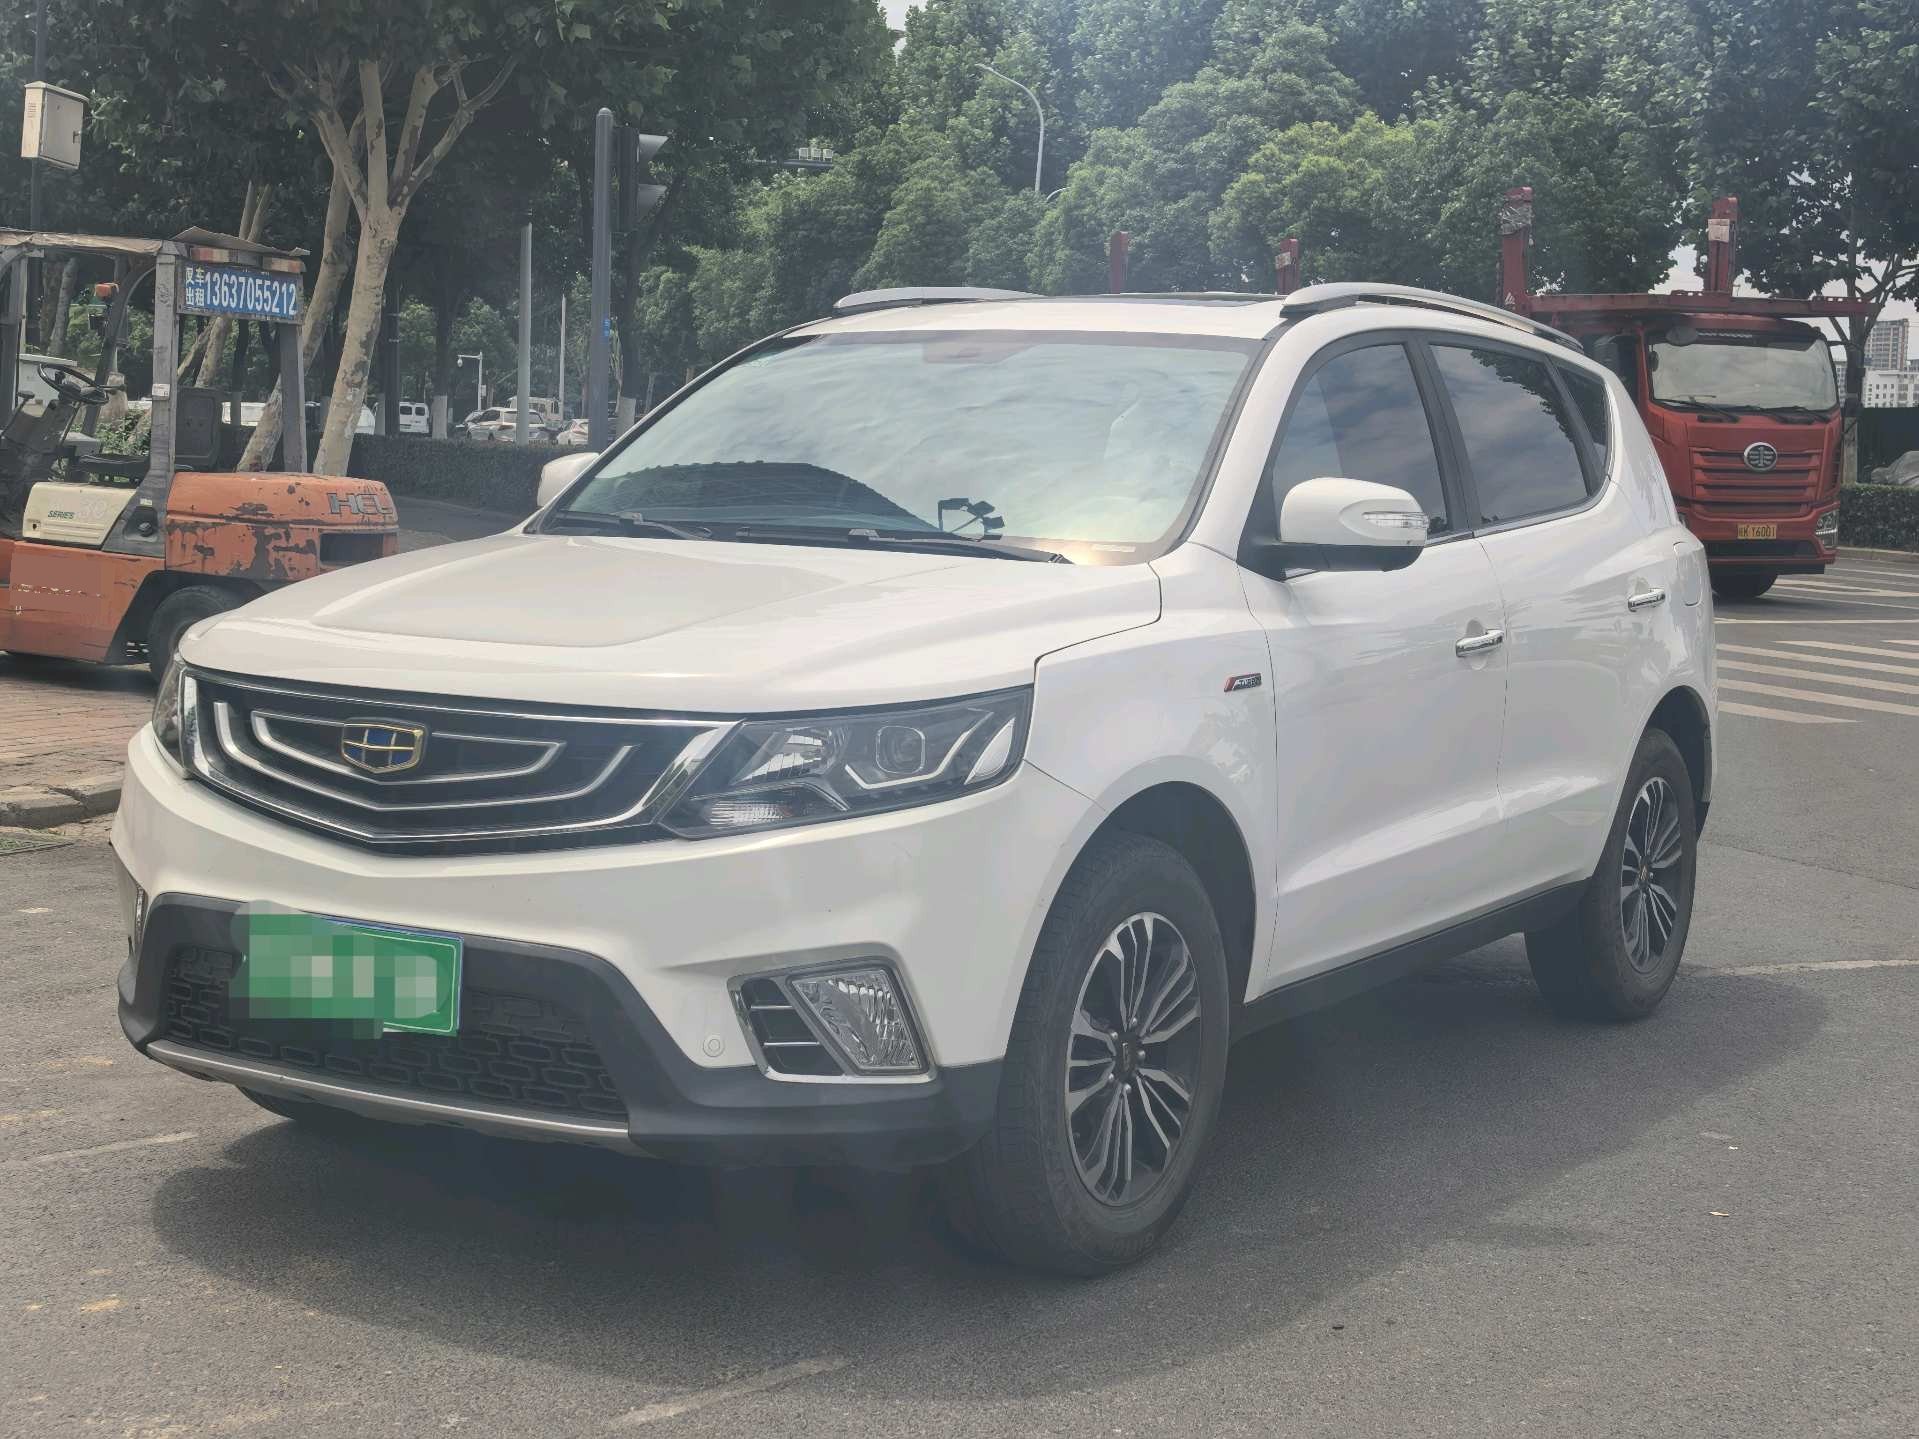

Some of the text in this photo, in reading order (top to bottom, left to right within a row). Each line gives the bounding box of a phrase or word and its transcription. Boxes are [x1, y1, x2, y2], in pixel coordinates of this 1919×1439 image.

[185, 287, 205, 307] 出租
[205, 271, 297, 316] 13637055212
[48, 510, 75, 519] SERIES
